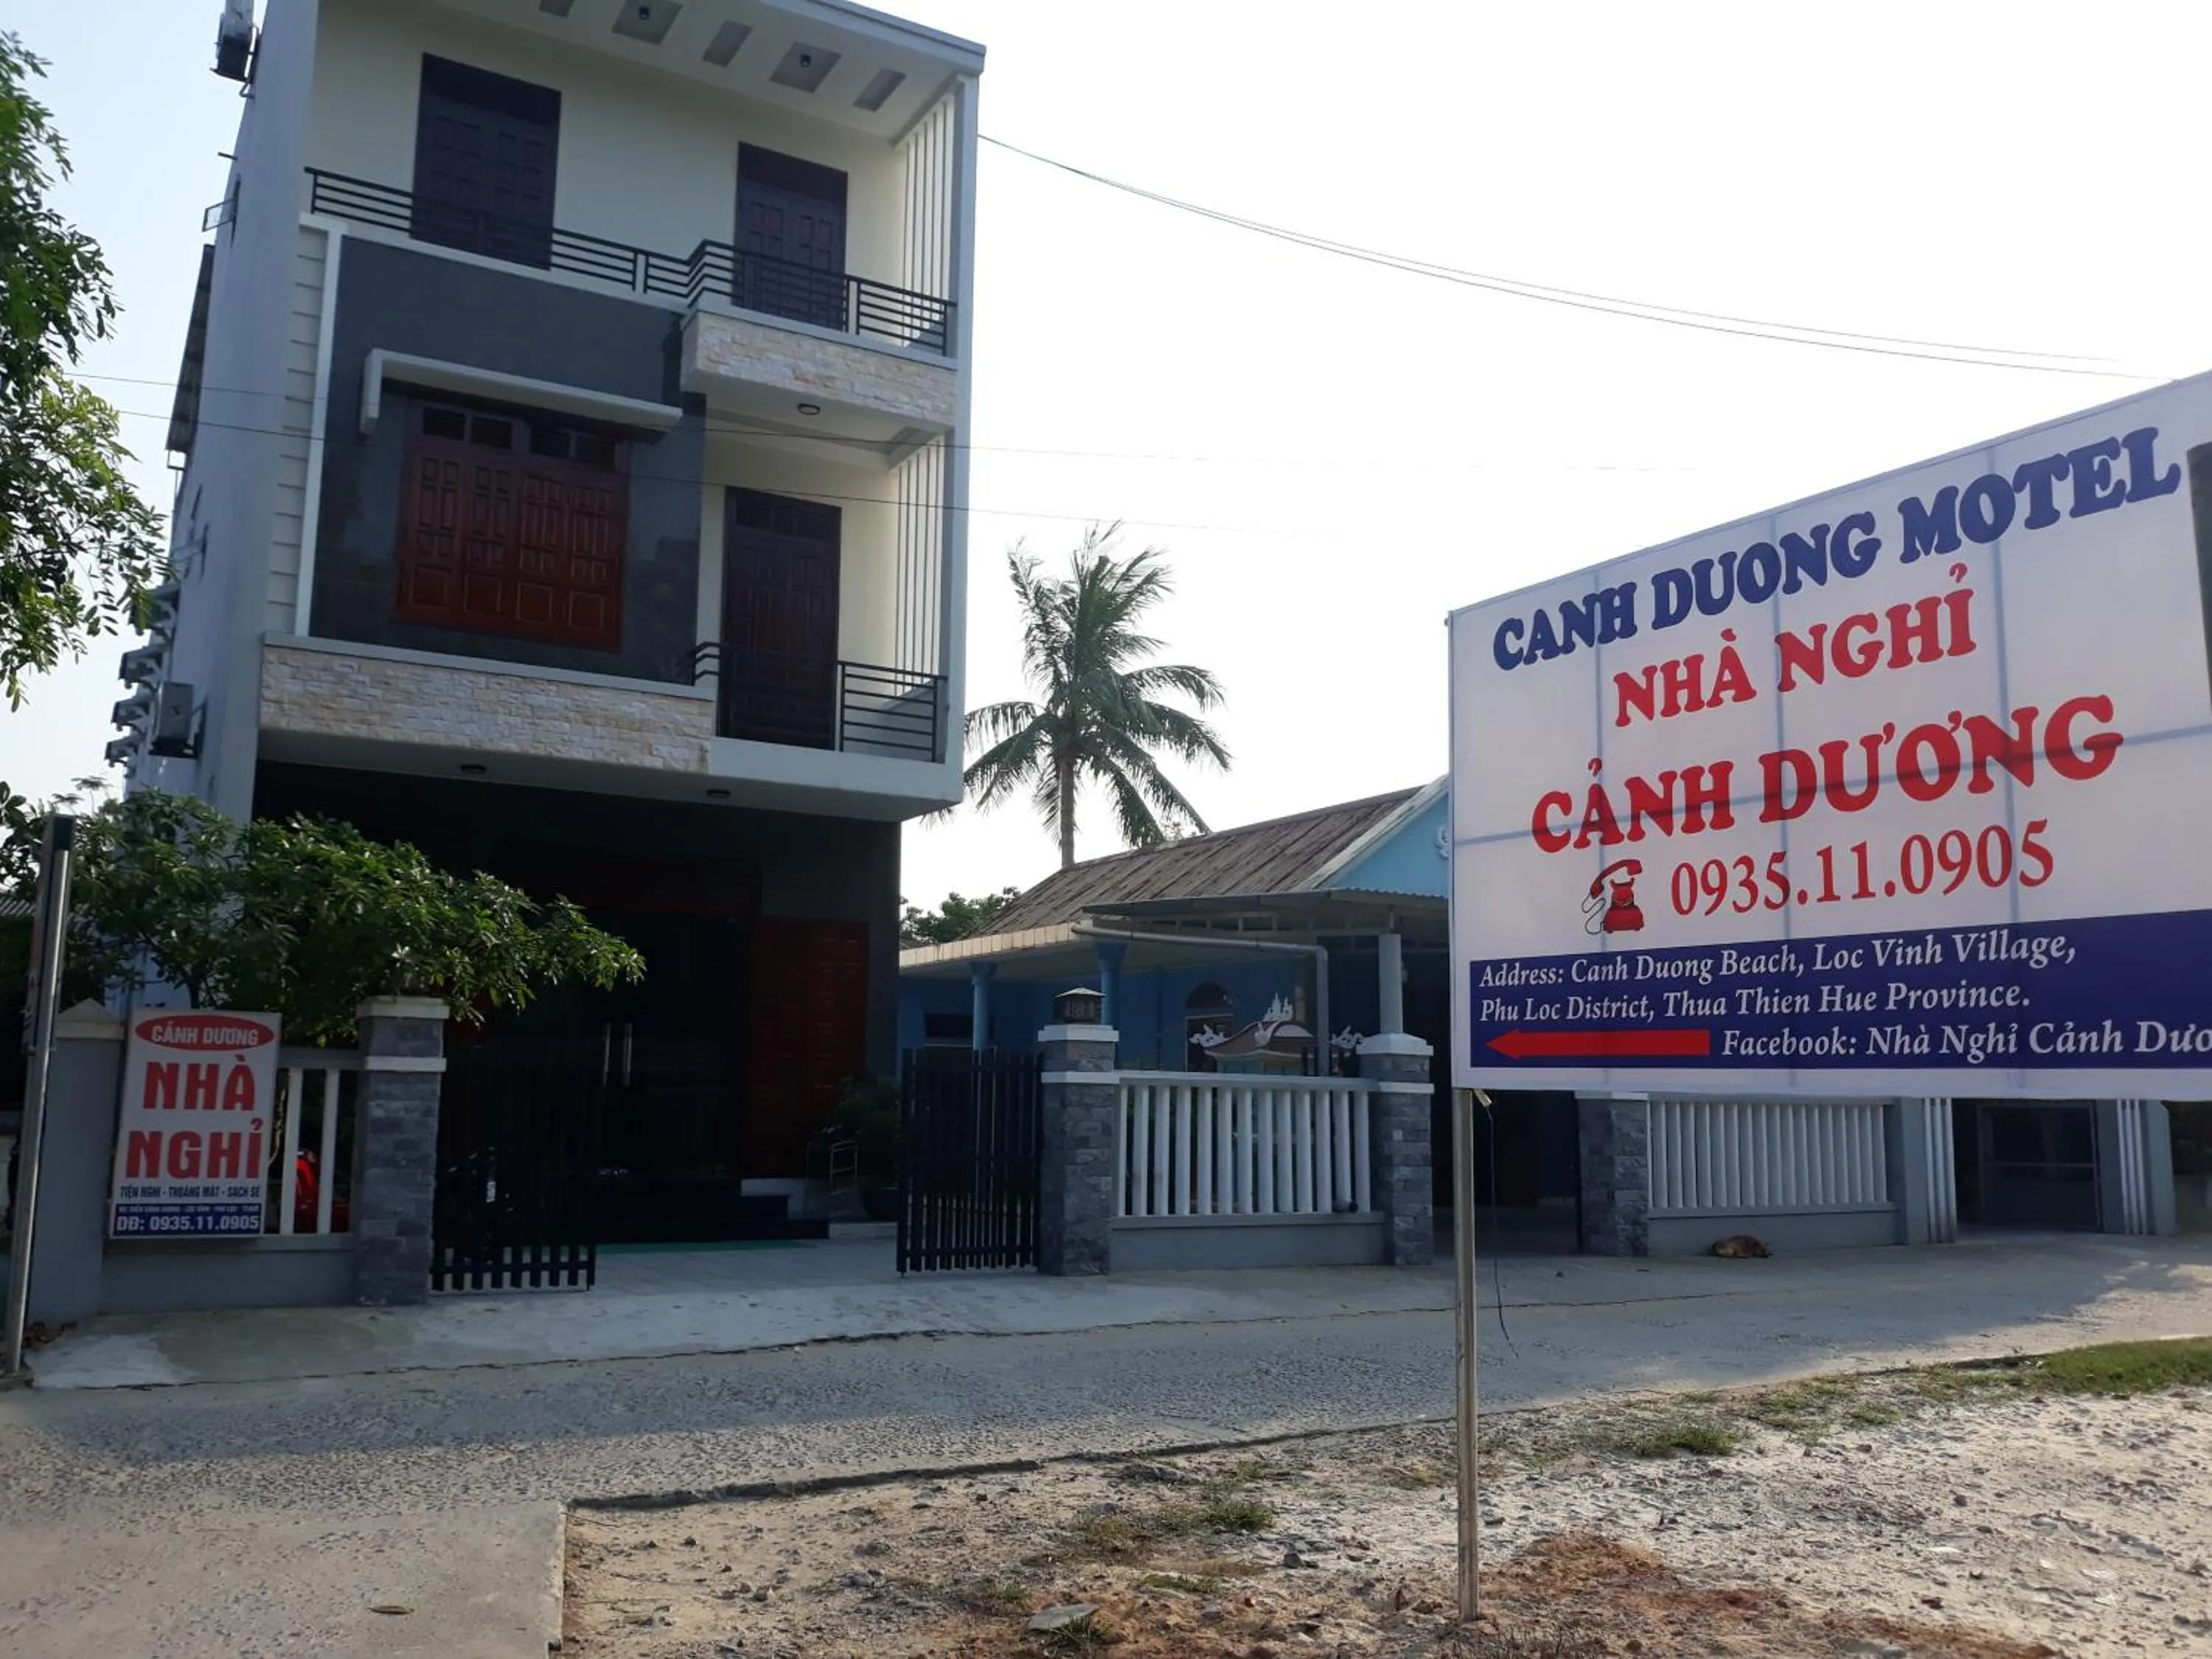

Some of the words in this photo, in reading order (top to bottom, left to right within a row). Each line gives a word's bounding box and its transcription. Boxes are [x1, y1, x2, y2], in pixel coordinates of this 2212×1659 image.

[1494, 582, 1638, 670] CANH
[1652, 512, 1882, 630] DUONG
[1898, 428, 2181, 563] MOTEL
[1616, 630, 1756, 728] NHÀ
[1775, 563, 1975, 692] NGHỈ
[1533, 759, 1734, 853] CẢNH
[1759, 695, 2124, 824] DƯƠNG
[1671, 818, 2053, 915] 0935.11.0905
[1479, 962, 1563, 987] Address:
[1571, 959, 1627, 983] Canh
[1635, 956, 1714, 985] Duong
[1719, 945, 1804, 977] Beach,
[1812, 944, 1863, 970] Loc
[1871, 935, 1943, 967] Vinh
[1952, 929, 2076, 968] Village,
[1481, 998, 1518, 1020] Phu
[1524, 998, 1560, 1020] Loc
[1566, 995, 1654, 1022] District,
[1663, 991, 1726, 1016] Thua
[1736, 987, 1809, 1014] Thien
[1818, 985, 1876, 1012] Hue
[1886, 980, 2029, 1009] Province.
[1722, 1026, 1856, 1055] Facebook:
[1866, 1025, 1930, 1054] Nhà
[1939, 1023, 2017, 1063] Nghỉ
[2030, 1020, 2123, 1053] Cảnh
[143, 1054, 255, 1110] NHÀ
[125, 1118, 263, 1178] NGHỈ
[150, 1216, 259, 1230] 0935.11.0905
